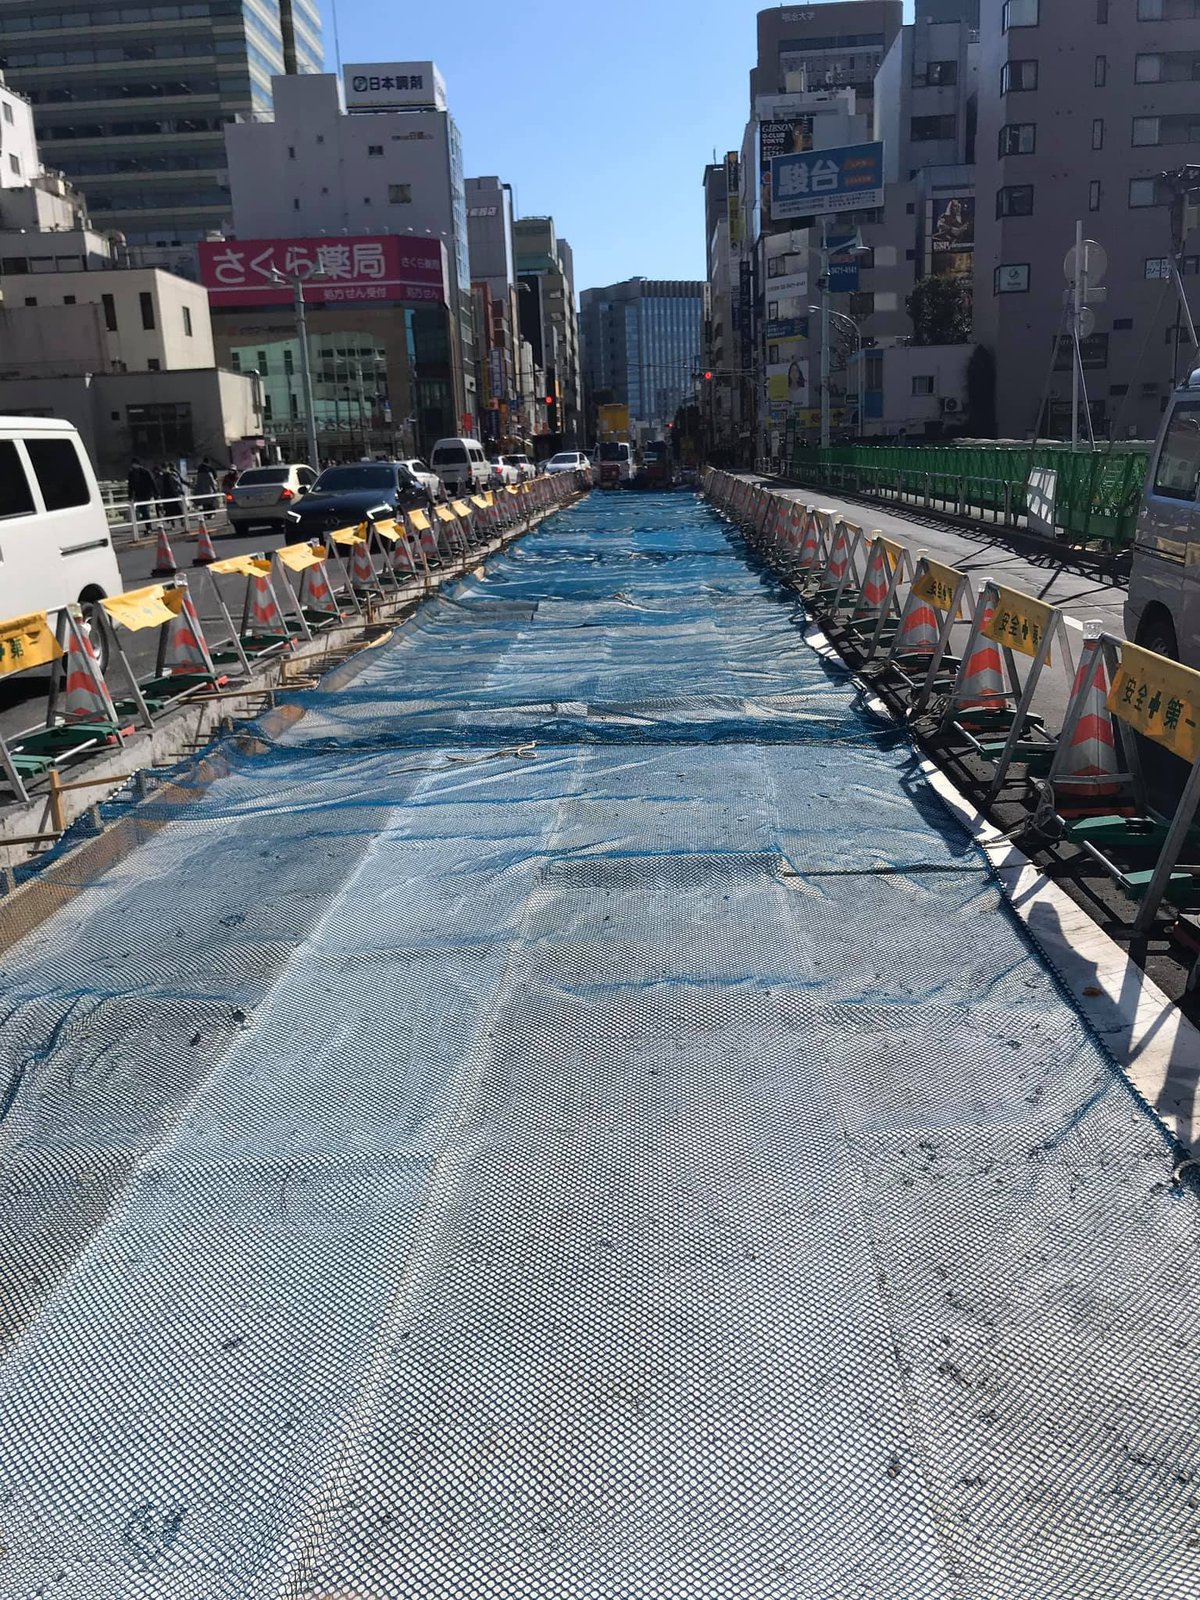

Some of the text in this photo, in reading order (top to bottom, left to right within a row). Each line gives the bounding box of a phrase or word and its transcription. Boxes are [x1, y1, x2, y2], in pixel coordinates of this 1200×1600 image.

[369, 75, 424, 91] 日本調剤
[762, 123, 794, 133] GIBSON
[778, 159, 840, 196] 駿台
[212, 243, 386, 284] さくら薬局
